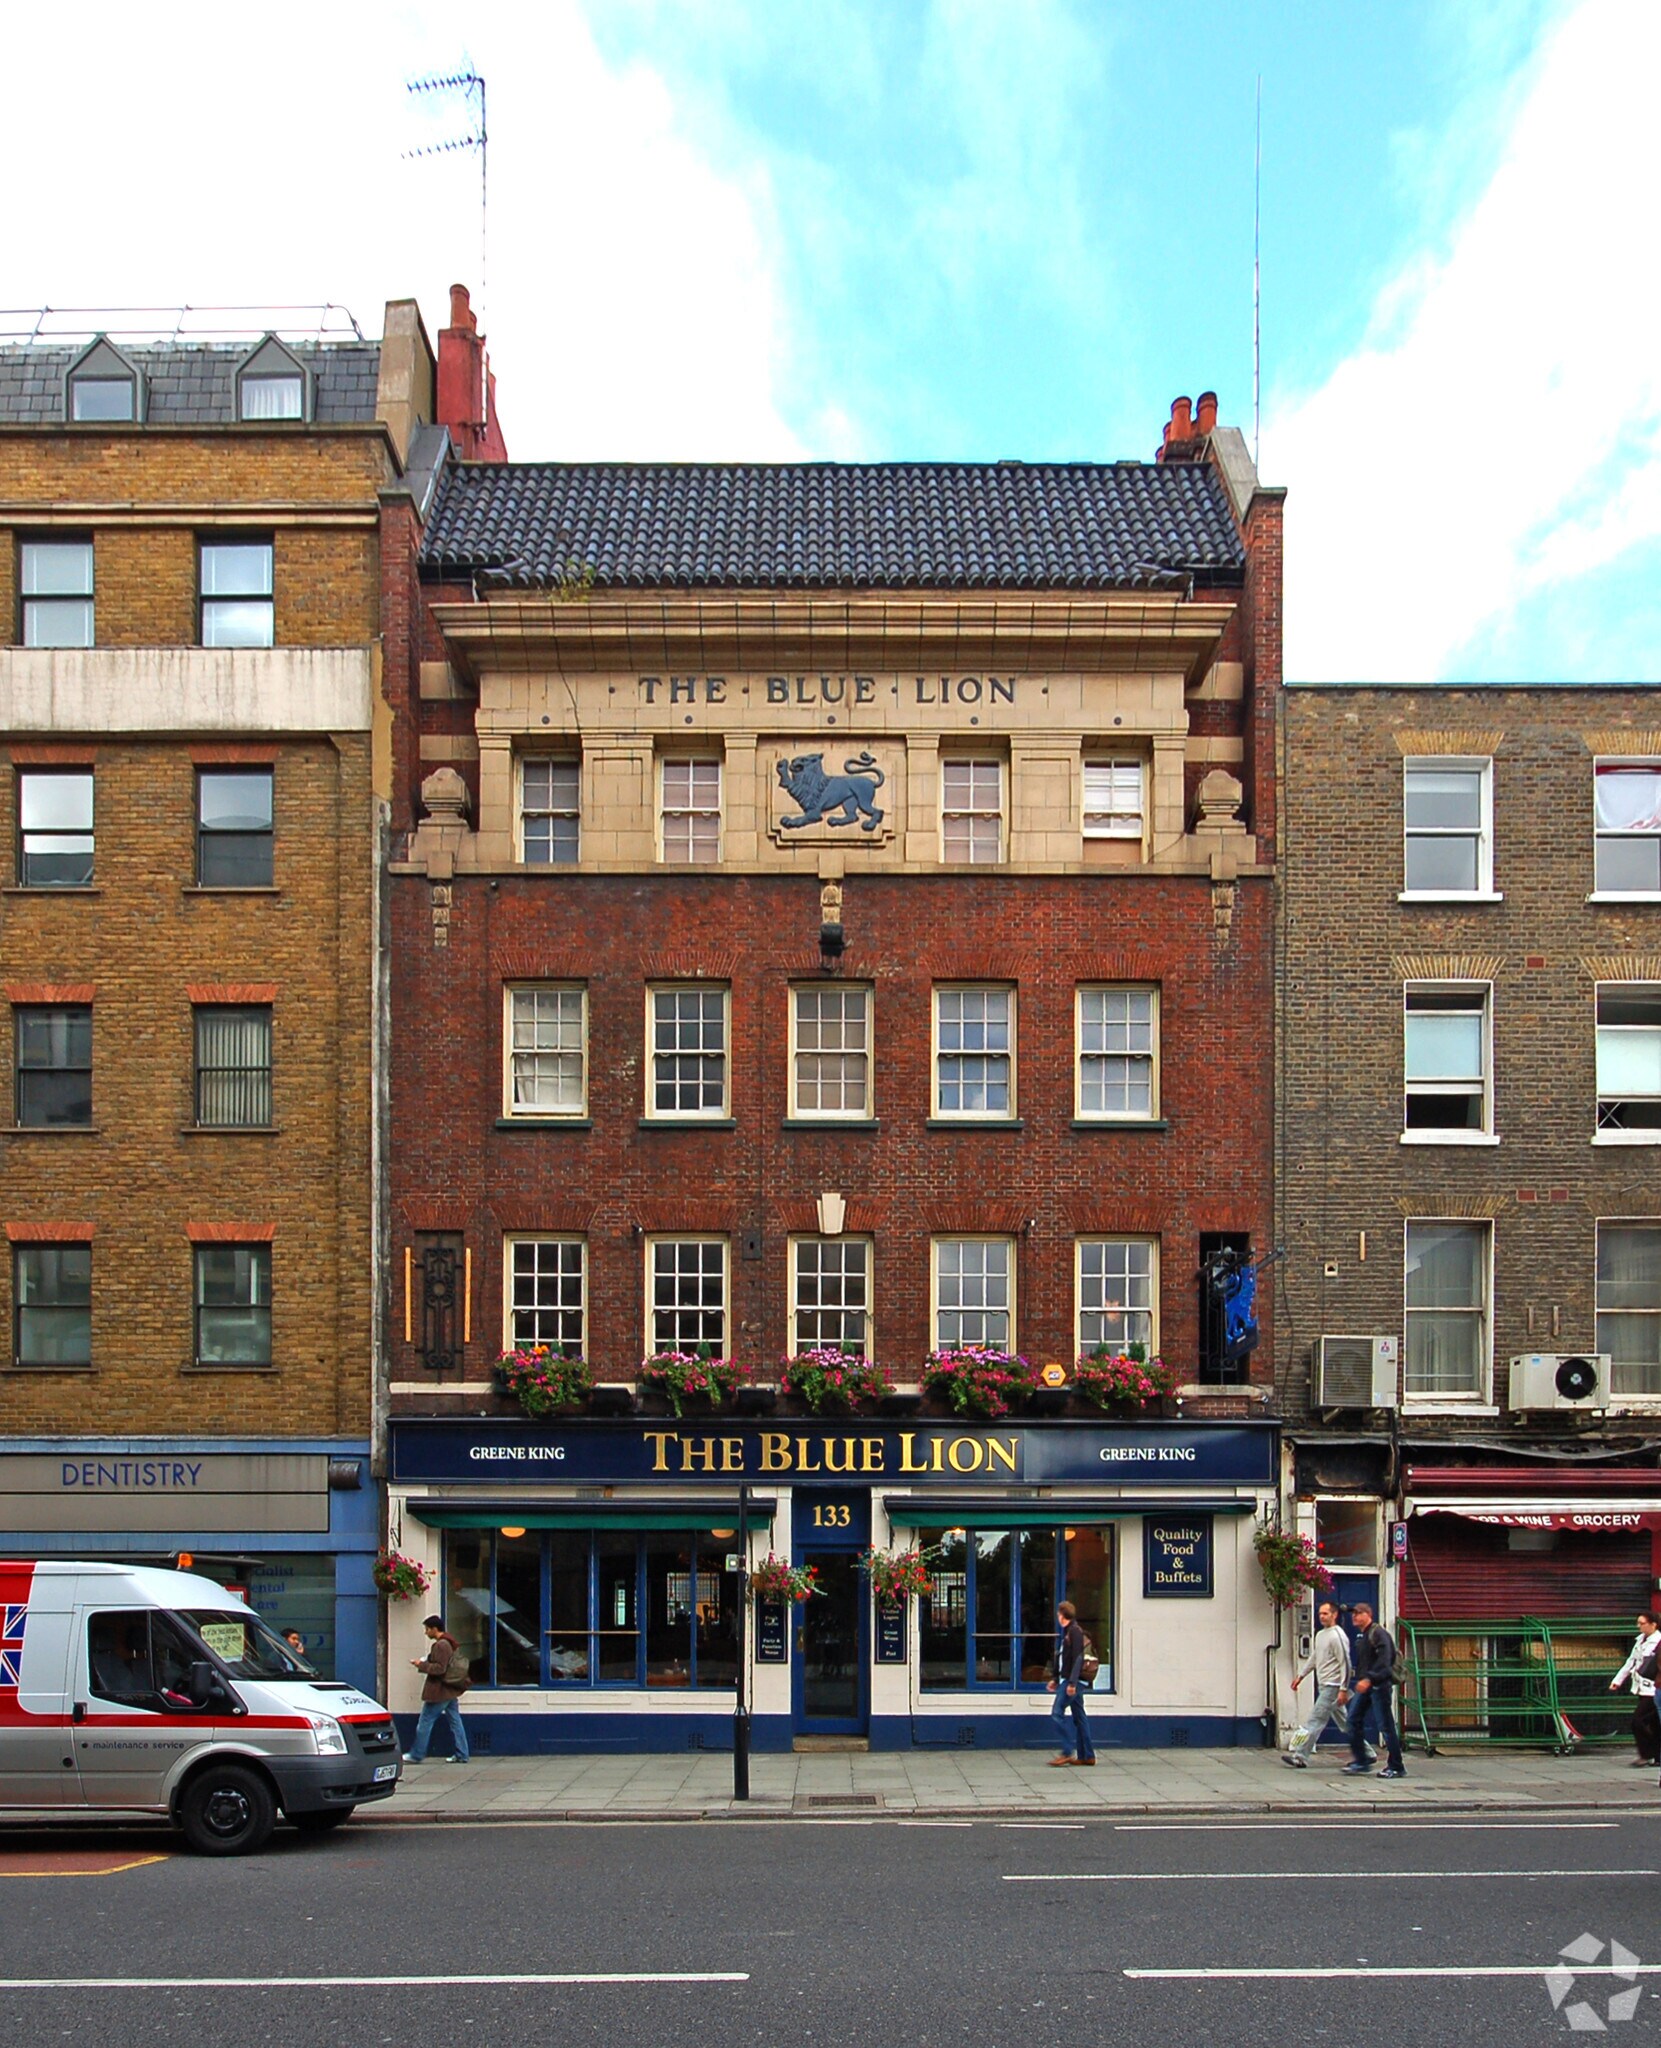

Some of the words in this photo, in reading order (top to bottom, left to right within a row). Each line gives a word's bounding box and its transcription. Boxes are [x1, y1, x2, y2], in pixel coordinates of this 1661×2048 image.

[638, 676, 727, 704] THE
[767, 676, 876, 704] BLUE
[915, 676, 1016, 704] LION
[469, 1446, 526, 1460] GREENE
[528, 1446, 565, 1460] KING
[643, 1432, 745, 1472] THE
[757, 1432, 885, 1472] BLUE
[898, 1432, 1019, 1472] LION
[1099, 1447, 1157, 1461] GREENE
[1158, 1447, 1196, 1461] KING
[62, 1462, 203, 1486] DENTISTRY
[812, 1504, 851, 1527] 133
[1515, 1515, 1553, 1526] WINE
[1572, 1514, 1641, 1526] GROCERY
[1153, 1528, 1203, 1542] Quality
[1162, 1543, 1195, 1555] Food
[1172, 1556, 1185, 1569] &
[1154, 1571, 1203, 1583] Buffets
[92, 1741, 149, 1749] maintenance
[152, 1741, 185, 1749] service
